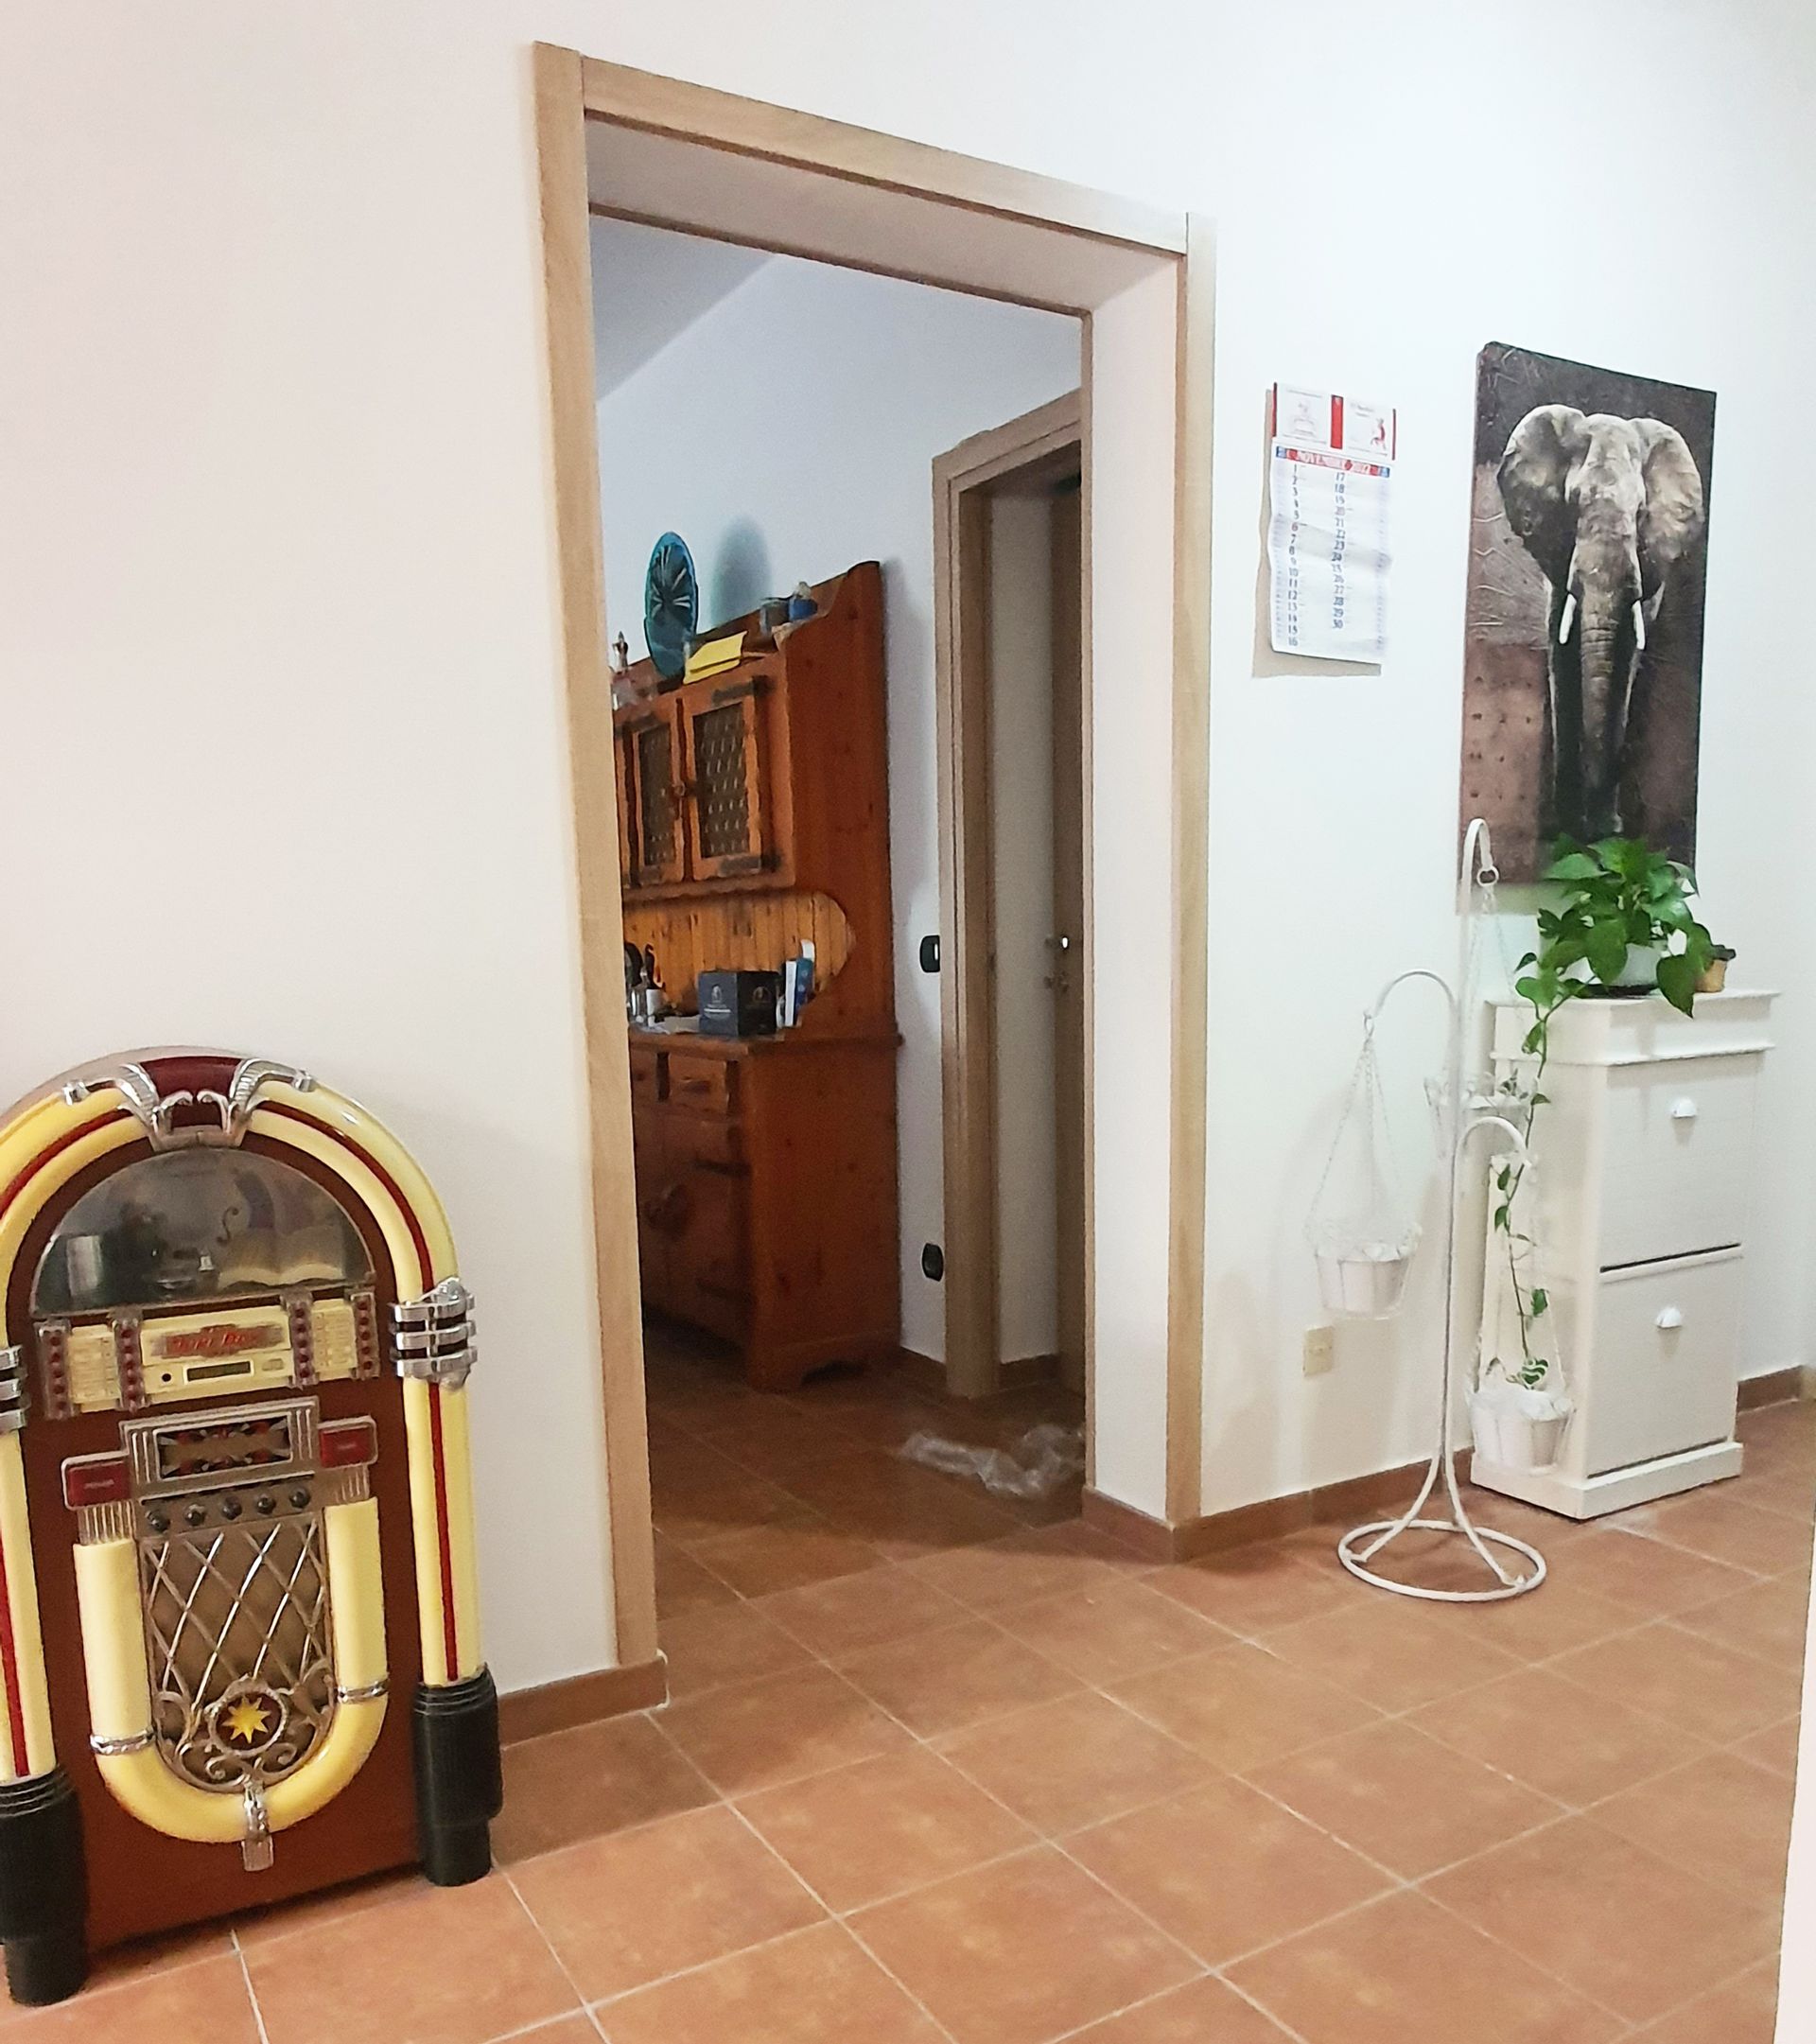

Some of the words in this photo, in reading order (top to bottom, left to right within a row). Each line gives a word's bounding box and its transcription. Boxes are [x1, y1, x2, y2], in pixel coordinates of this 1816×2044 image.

[1336, 472, 1345, 481] 17
[1335, 483, 1345, 494] 18
[1289, 578, 1298, 587] 11
[1288, 590, 1298, 600] 12
